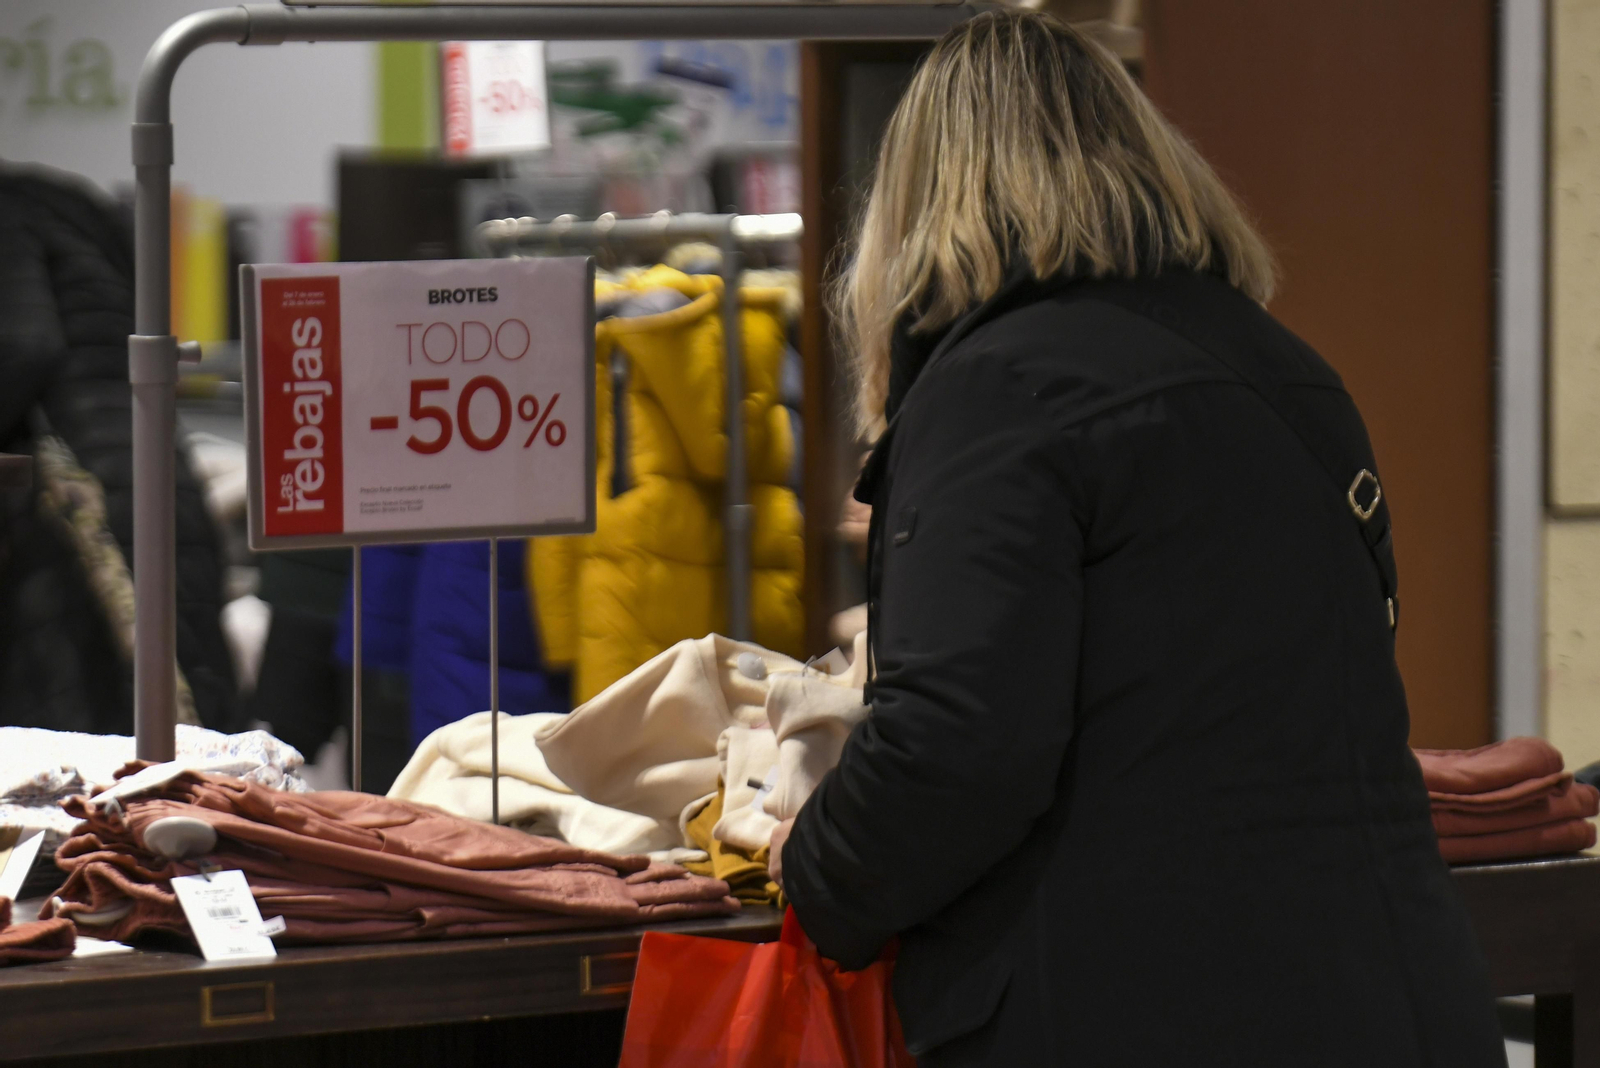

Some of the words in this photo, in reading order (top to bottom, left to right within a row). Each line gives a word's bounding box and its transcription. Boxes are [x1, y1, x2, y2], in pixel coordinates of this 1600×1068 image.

[428, 286, 499, 305] BROTES
[396, 318, 531, 365] TODO
[283, 316, 333, 512] rebajas
[370, 374, 567, 455] -50%
[277, 473, 294, 513] Las
